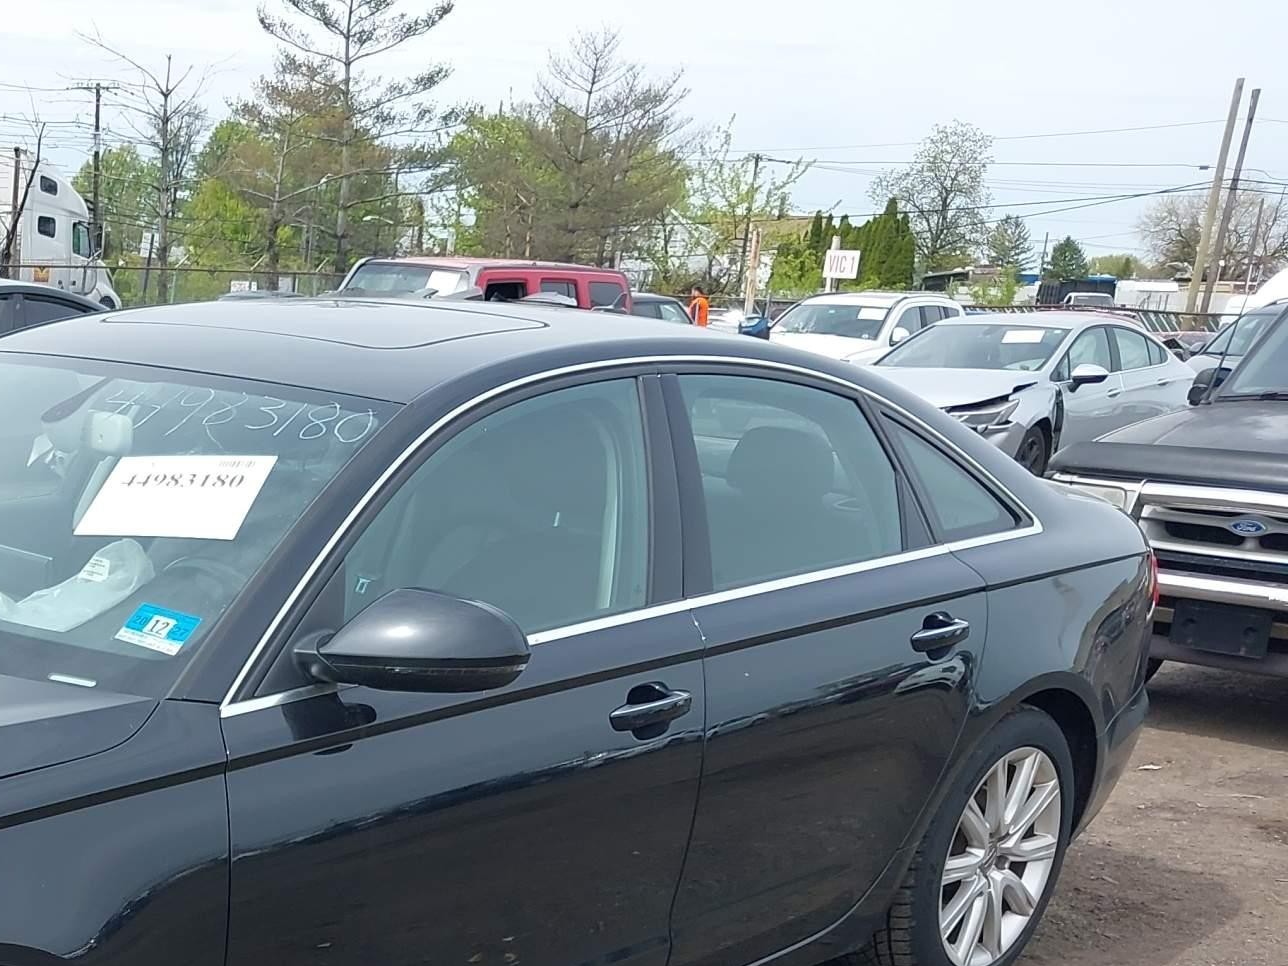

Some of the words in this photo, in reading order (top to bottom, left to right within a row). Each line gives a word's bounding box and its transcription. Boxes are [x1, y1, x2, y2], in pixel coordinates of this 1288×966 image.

[829, 254, 847, 274] VIC
[120, 473, 246, 488] 44983180
[148, 619, 170, 635] 12
